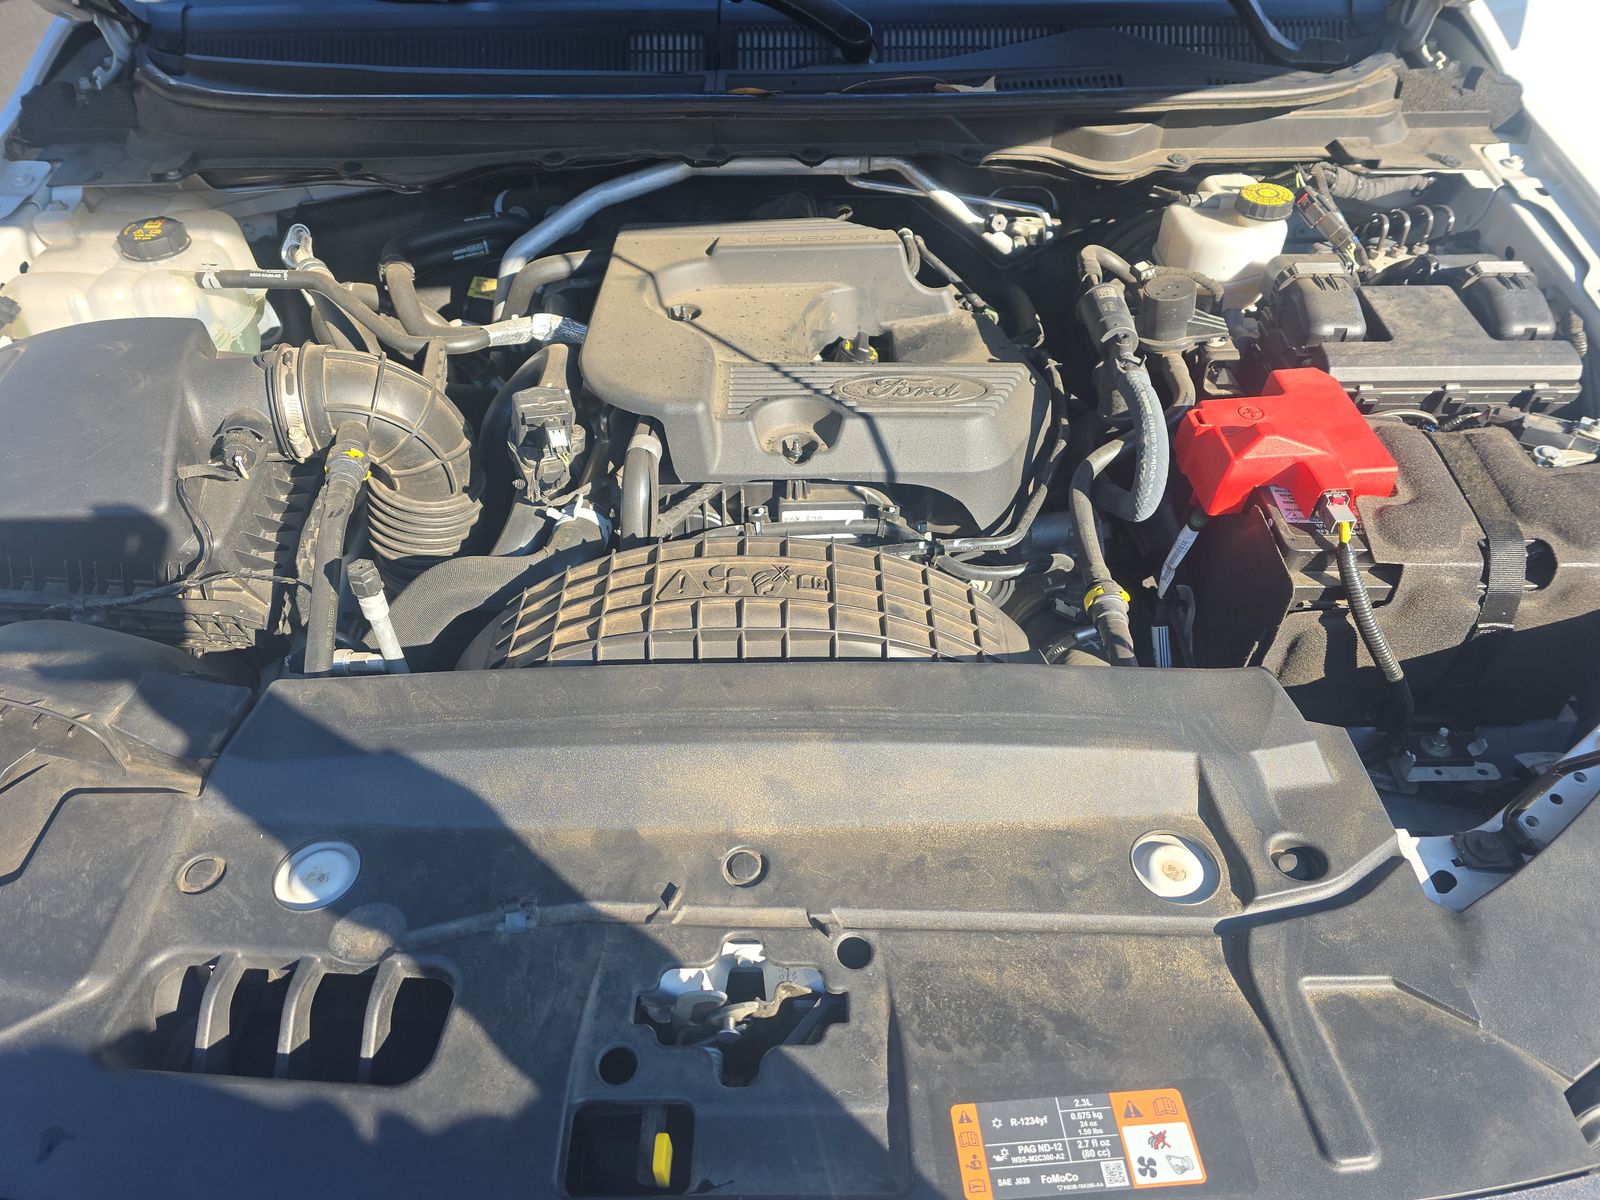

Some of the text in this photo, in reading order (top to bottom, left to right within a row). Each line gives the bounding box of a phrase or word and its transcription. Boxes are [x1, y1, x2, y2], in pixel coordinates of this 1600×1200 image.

[867, 377, 961, 399] Ford
[1073, 1098, 1093, 1107] 2.3L
[1009, 1115, 1048, 1127] R-1234yf
[1070, 1111, 1103, 1120] 0.675 kg
[1017, 1142, 1063, 1154] PAG ND-12
[1076, 1139, 1111, 1149] 2.7 fl oz
[1010, 1153, 1065, 1164] WSS-M2C300-A2
[1081, 1148, 1111, 1159] (80 cc)
[997, 1176, 1031, 1187] SAE J639
[1041, 1173, 1079, 1184] FoMoCo
